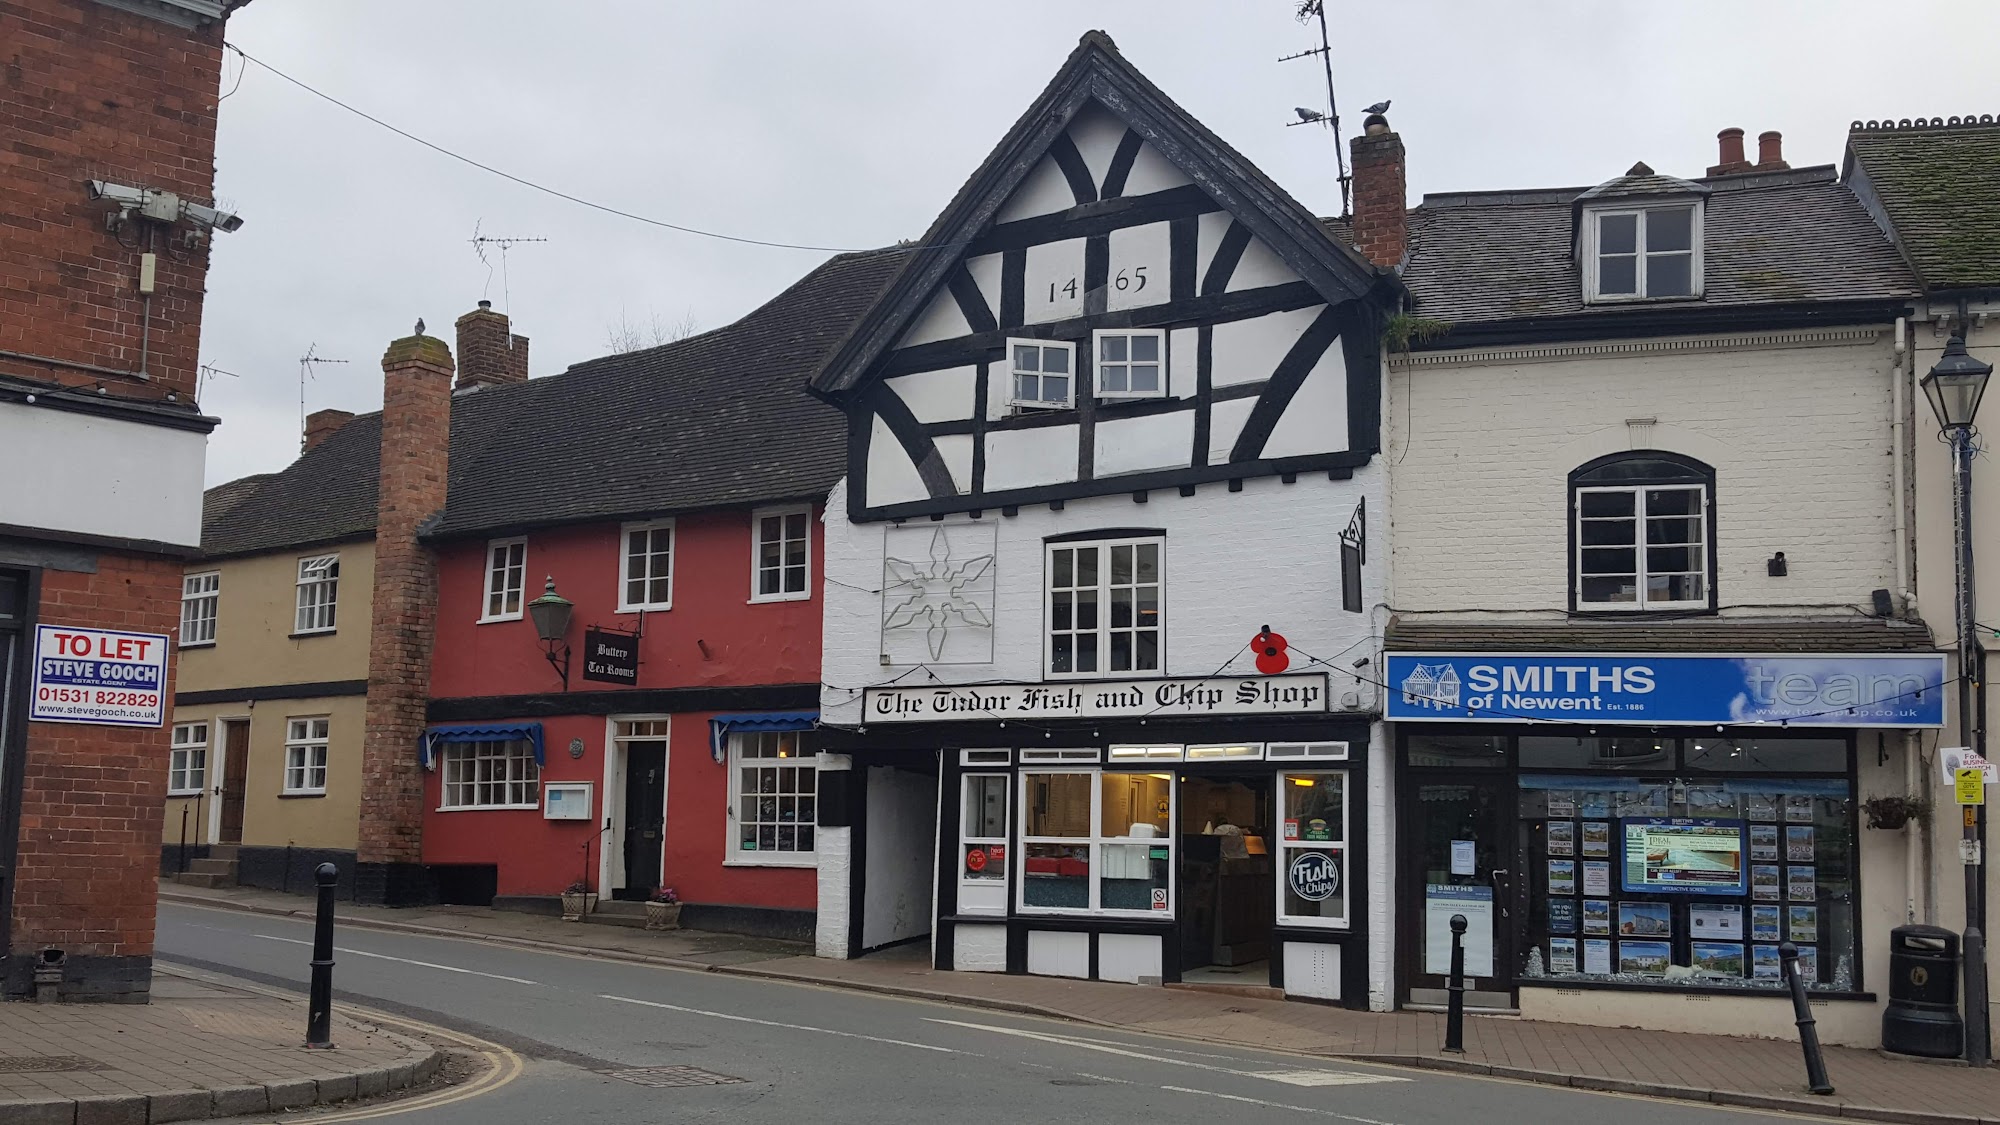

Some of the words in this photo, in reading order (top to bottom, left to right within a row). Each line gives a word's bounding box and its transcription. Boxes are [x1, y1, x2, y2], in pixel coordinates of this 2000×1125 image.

[1049, 277, 1078, 303] 14
[1115, 266, 1147, 294] 65
[54, 633, 92, 657] TO
[99, 637, 151, 661] LET
[596, 643, 628, 660] Buttery
[43, 659, 94, 678] STEVE
[100, 663, 157, 682] GOOCH
[588, 660, 605, 674] Tea
[606, 663, 635, 677] Rooms
[1467, 665, 1656, 694] SMITHS
[101, 679, 127, 687] AGENT
[1748, 665, 1927, 706] team
[39, 687, 89, 703] 01531
[95, 691, 158, 708] 822829
[876, 692, 923, 718] The
[932, 690, 1011, 713] Tudor
[1017, 688, 1082, 714] Fish
[1095, 685, 1144, 708] and
[1155, 682, 1223, 710] Chip
[1235, 680, 1319, 708] Shop
[1467, 693, 1494, 710] of
[1501, 693, 1602, 711] Newent
[1607, 703, 1623, 711] Est.
[1625, 703, 1645, 711] 1886
[38, 705, 156, 719] www.stevegooch.co.uk
[1294, 860, 1334, 884] Fish
[1306, 881, 1332, 894] Chips
